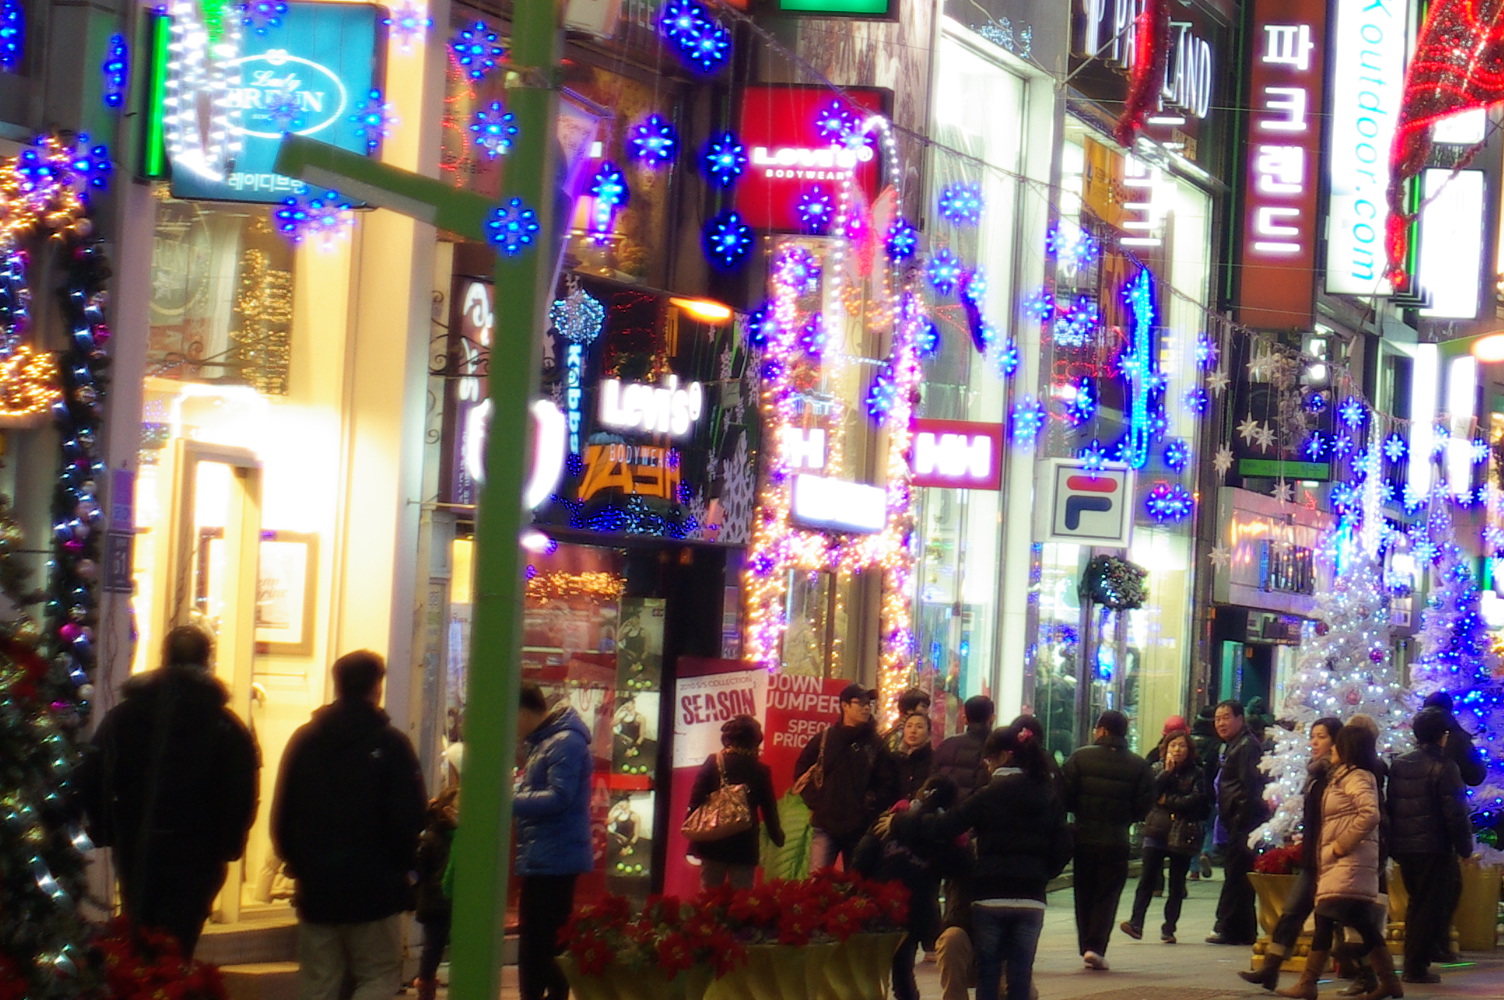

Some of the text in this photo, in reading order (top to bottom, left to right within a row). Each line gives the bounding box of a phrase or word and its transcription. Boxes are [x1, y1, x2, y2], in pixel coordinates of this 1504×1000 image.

[227, 87, 326, 113] BREN
[1254, 23, 1314, 253] 파크랜드
[765, 168, 846, 181] BODYWEAR
[768, 674, 823, 694] DOWN
[681, 688, 757, 726] SEASON
